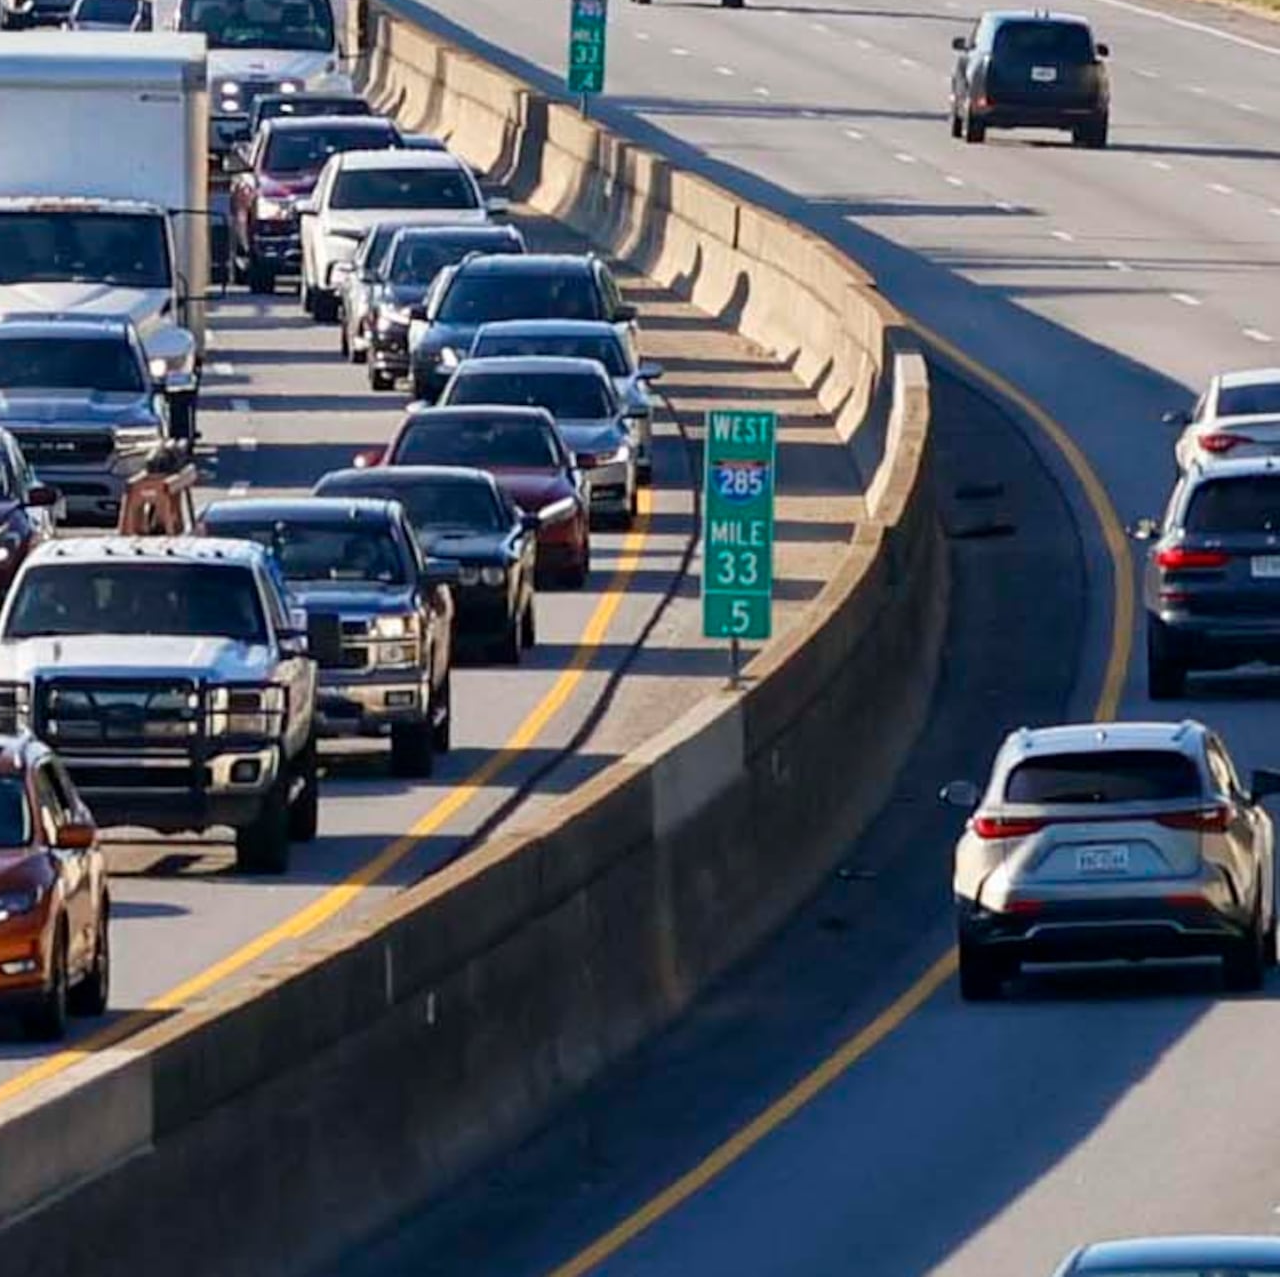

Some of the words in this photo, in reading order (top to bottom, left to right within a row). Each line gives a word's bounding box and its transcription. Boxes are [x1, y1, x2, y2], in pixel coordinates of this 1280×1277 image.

[712, 414, 769, 444] WEST
[720, 468, 763, 496] 285
[711, 520, 765, 547] MILE
[716, 551, 758, 585] 33
[721, 599, 750, 634] .5
